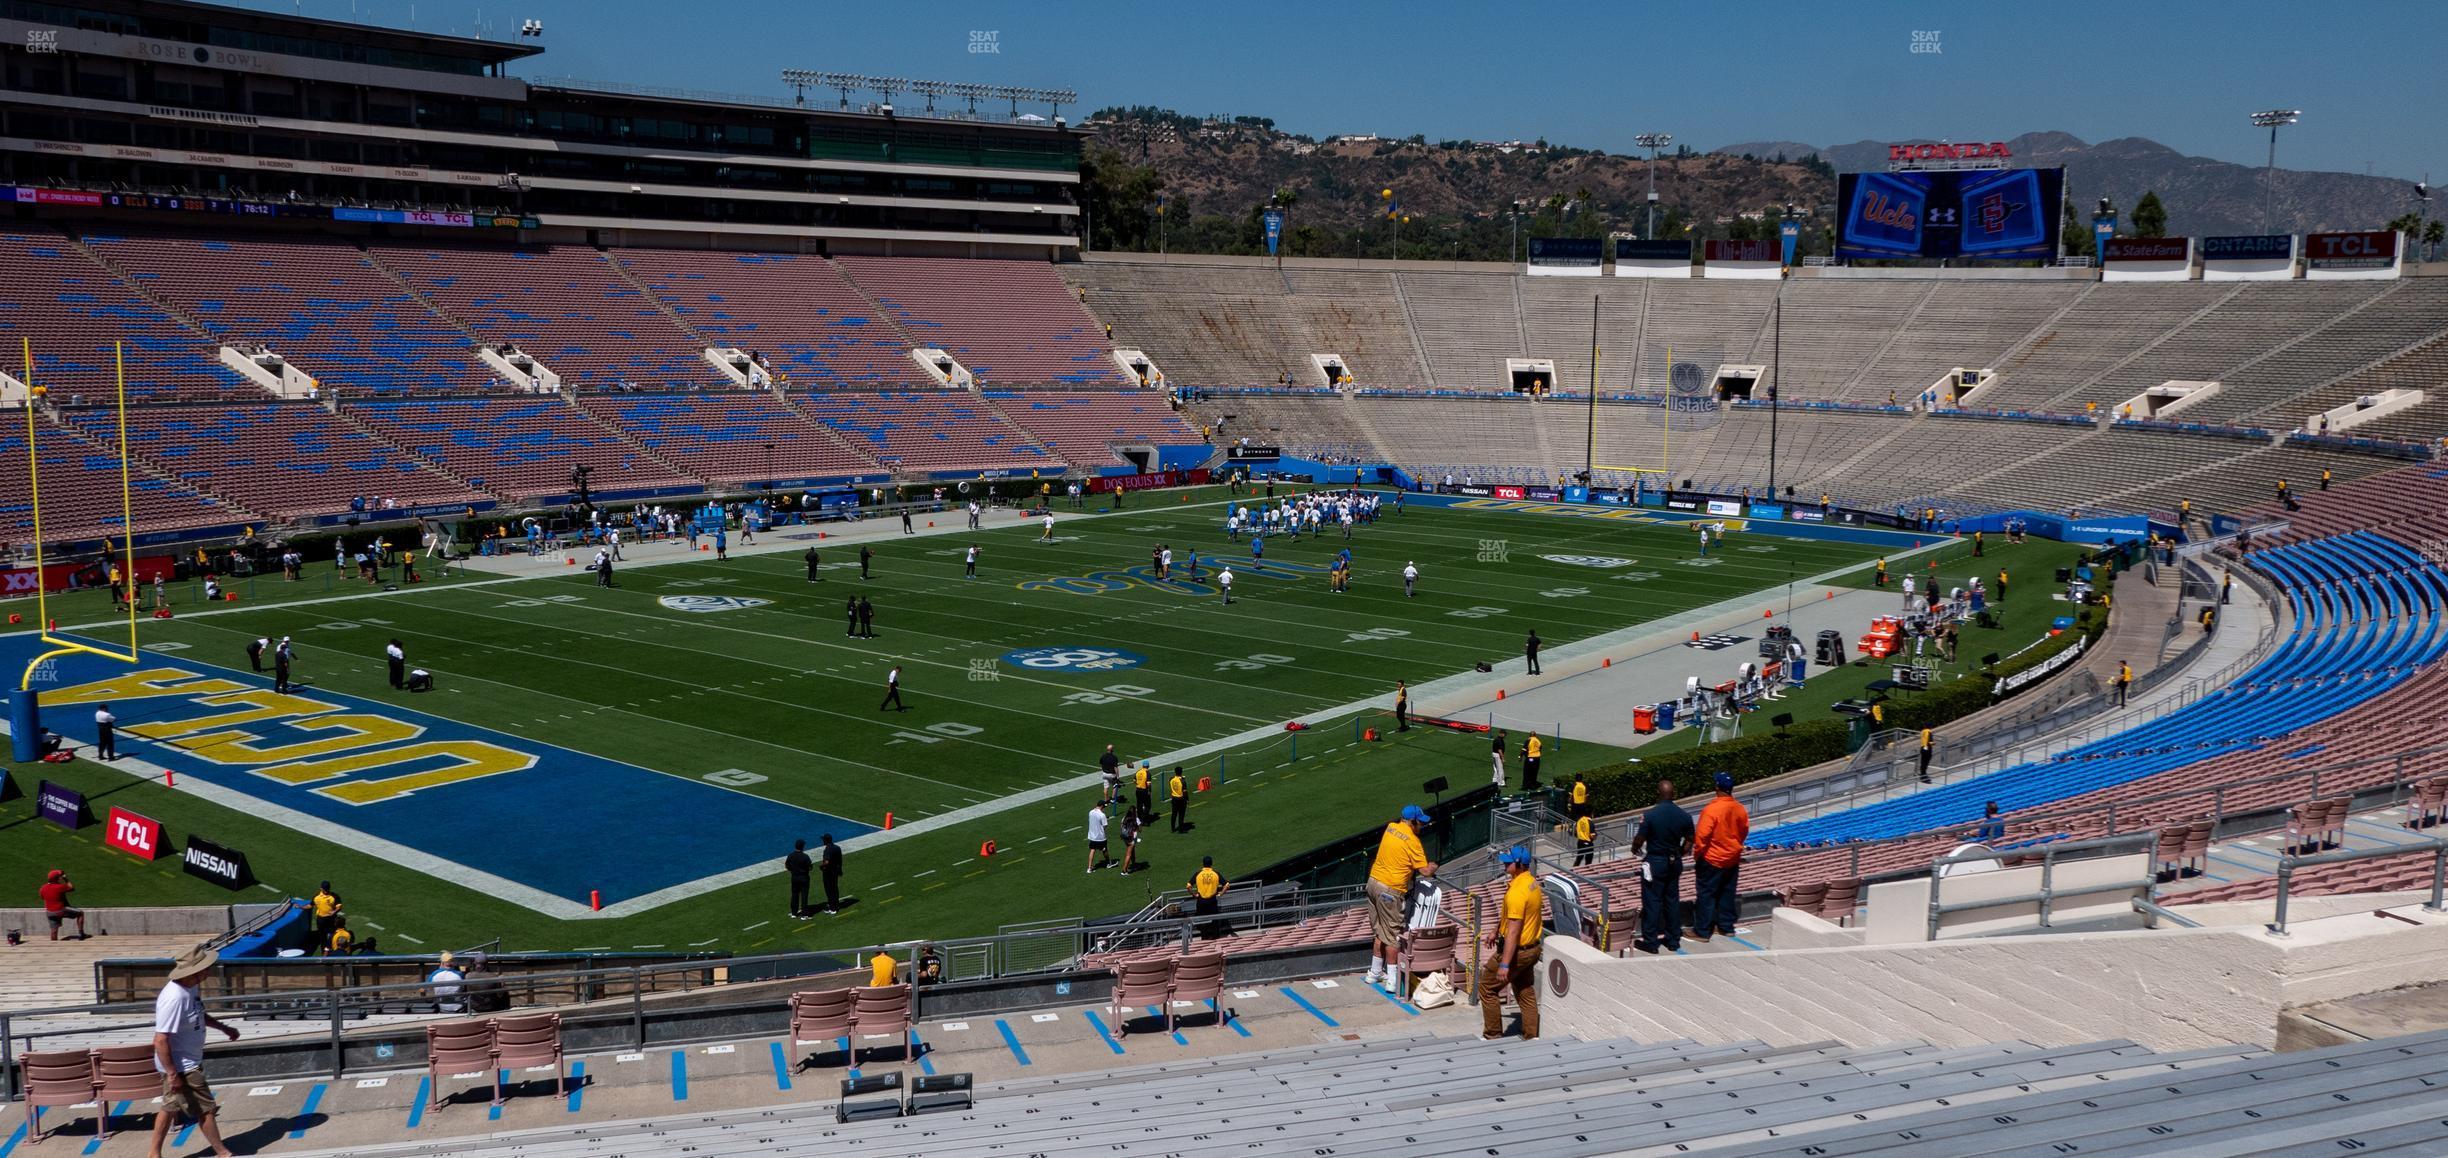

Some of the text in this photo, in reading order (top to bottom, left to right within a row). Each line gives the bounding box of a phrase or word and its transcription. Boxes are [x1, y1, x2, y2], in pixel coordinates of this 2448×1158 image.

[138, 42, 262, 68] ROSE BOWL
[1888, 142, 2013, 161] HONDA
[411, 212, 435, 222] TCL
[444, 213, 469, 223] TCL
[2320, 235, 2379, 257] TCL
[1658, 396, 1713, 412] Allstate
[1104, 473, 1168, 490] DOS EQUIS XX
[1461, 486, 1489, 495] NISSAN
[1498, 488, 1520, 498] TCL
[2150, 509, 2180, 524] HONDA
[2081, 526, 2145, 536] UNDER ARMOUR
[5, 572, 40, 592] XX
[1346, 627, 1412, 641] 40
[1217, 653, 1297, 671] 30
[1064, 684, 1157, 705] 20
[892, 722, 985, 744] 10
[702, 768, 769, 787] G
[115, 817, 151, 851] TCL
[185, 847, 238, 880] NISSAN
[2419, 1078, 2435, 1086] 7
[1994, 1115, 2019, 1125] 10
[1768, 1129, 1780, 1137] 7
[1898, 1131, 1922, 1140] 11
[2147, 1125, 2174, 1135] 10
[1800, 1146, 1827, 1156] 12
[2052, 1142, 2078, 1153] 11
[2337, 1138, 2366, 1150] 10
